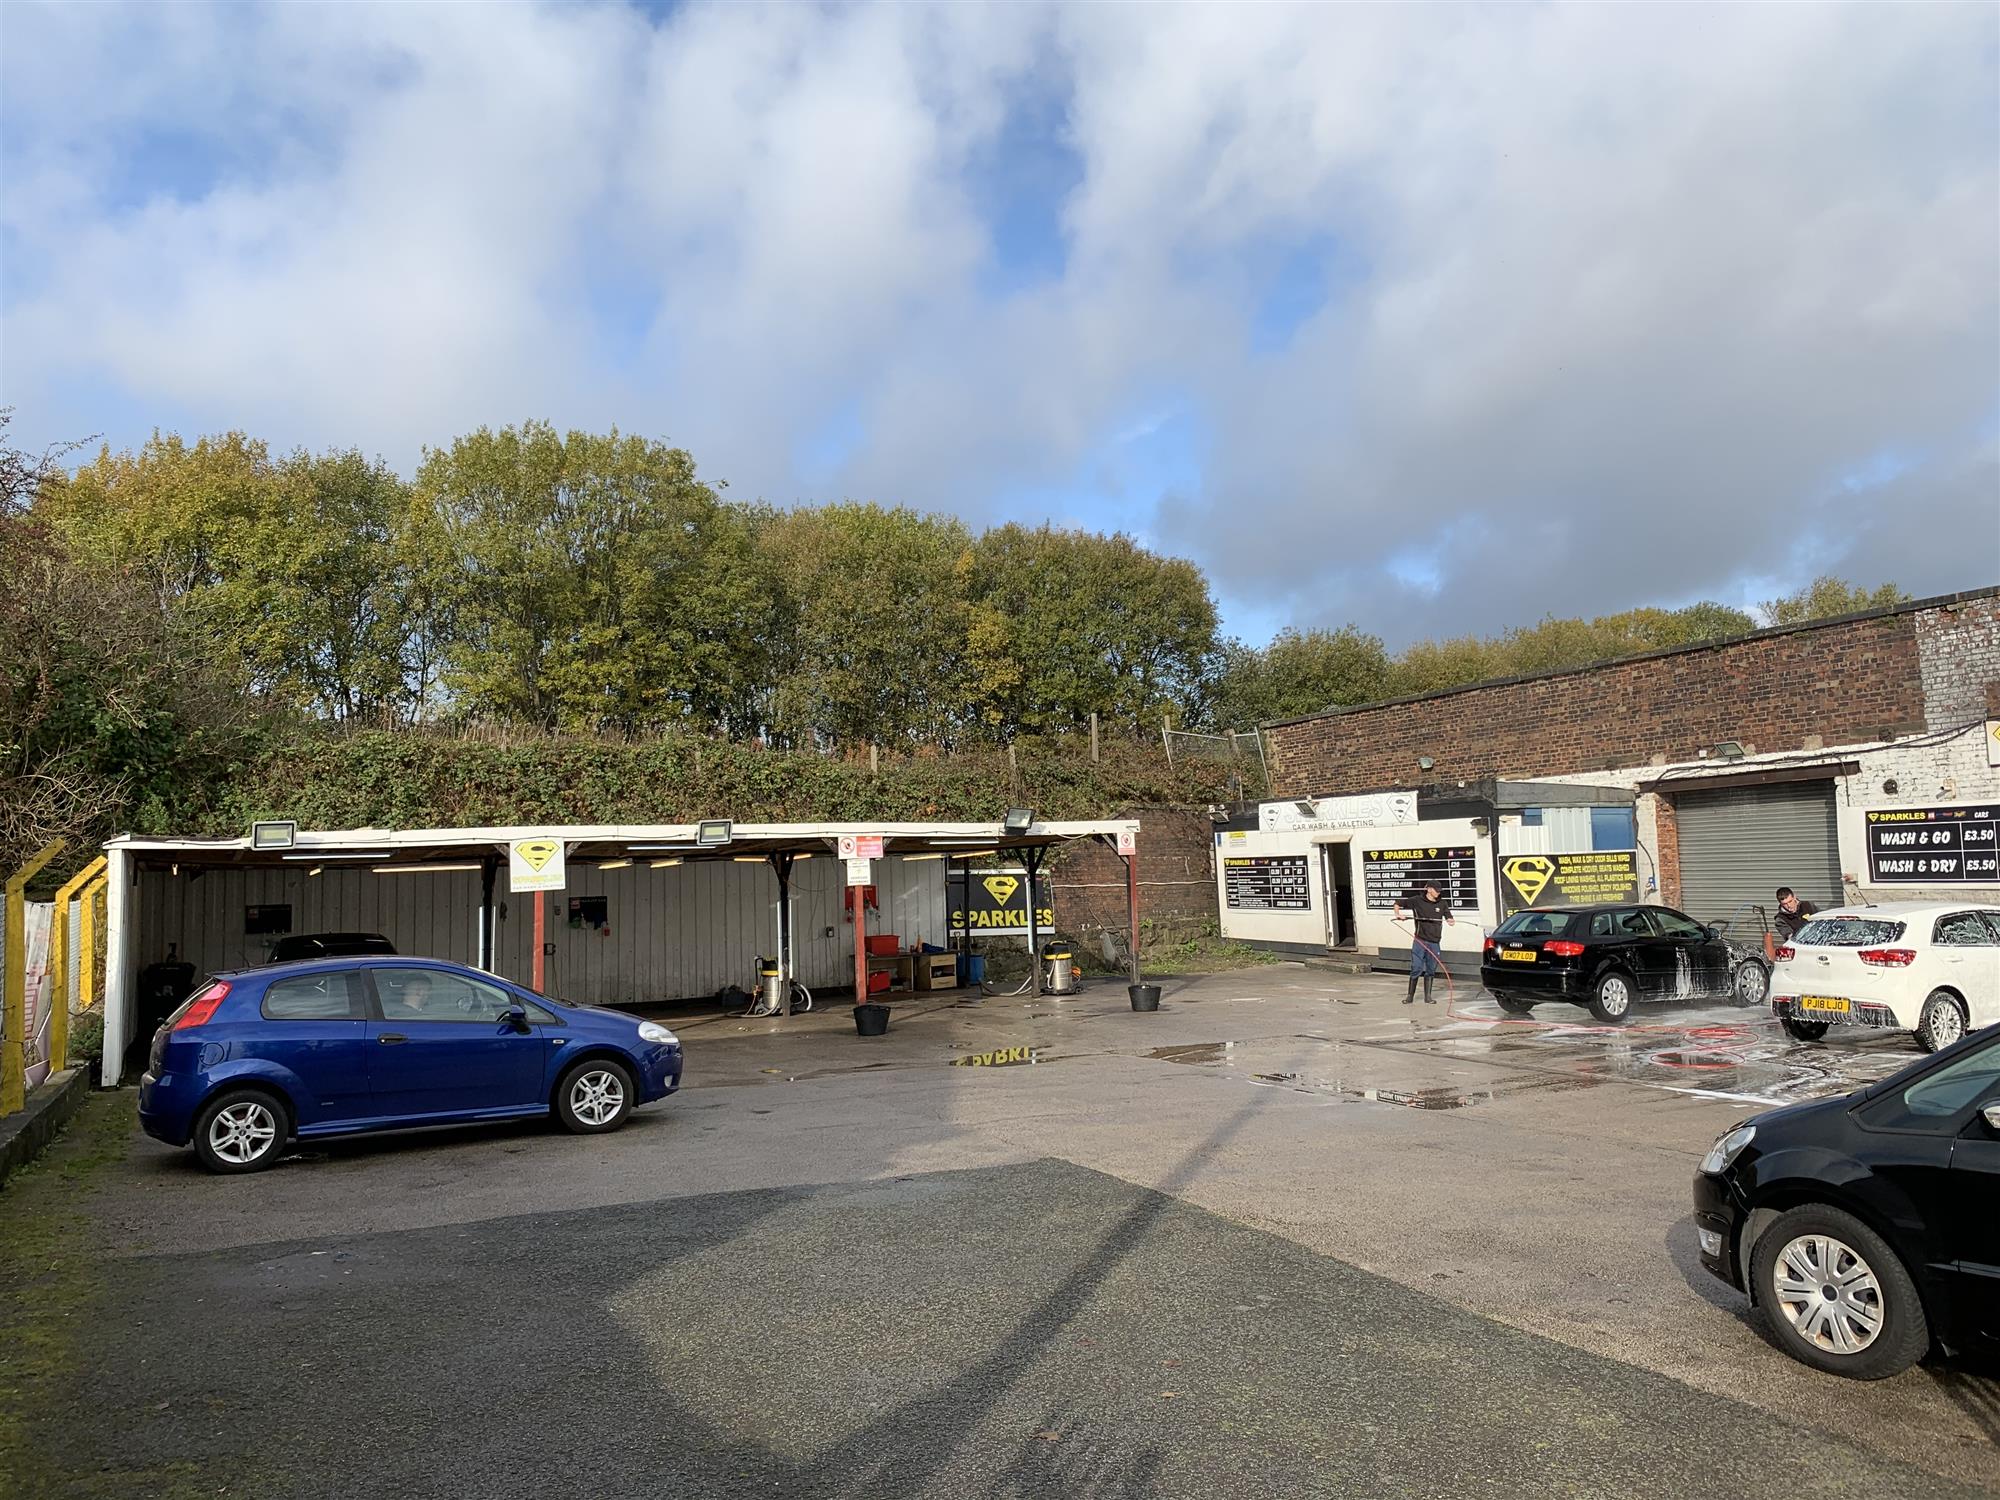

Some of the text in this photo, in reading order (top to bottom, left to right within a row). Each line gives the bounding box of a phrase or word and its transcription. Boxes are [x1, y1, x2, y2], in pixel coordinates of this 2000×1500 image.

[1284, 796, 1383, 823] SRKLES
[1974, 811, 1990, 819] CARS
[1880, 813, 1926, 821] SPARKLES
[1307, 822, 1328, 830] WASH
[1337, 819, 1374, 828] VALETING
[1880, 831, 1951, 845] WASH & GO
[1964, 830, 1994, 841] £3.50
[1383, 850, 1424, 859] SPARKLES
[1879, 859, 1957, 873] WASH & DRY
[1966, 860, 1996, 870] £5.50
[952, 909, 1053, 928] SPARKLES
[1807, 1000, 1824, 1009] PJ18
